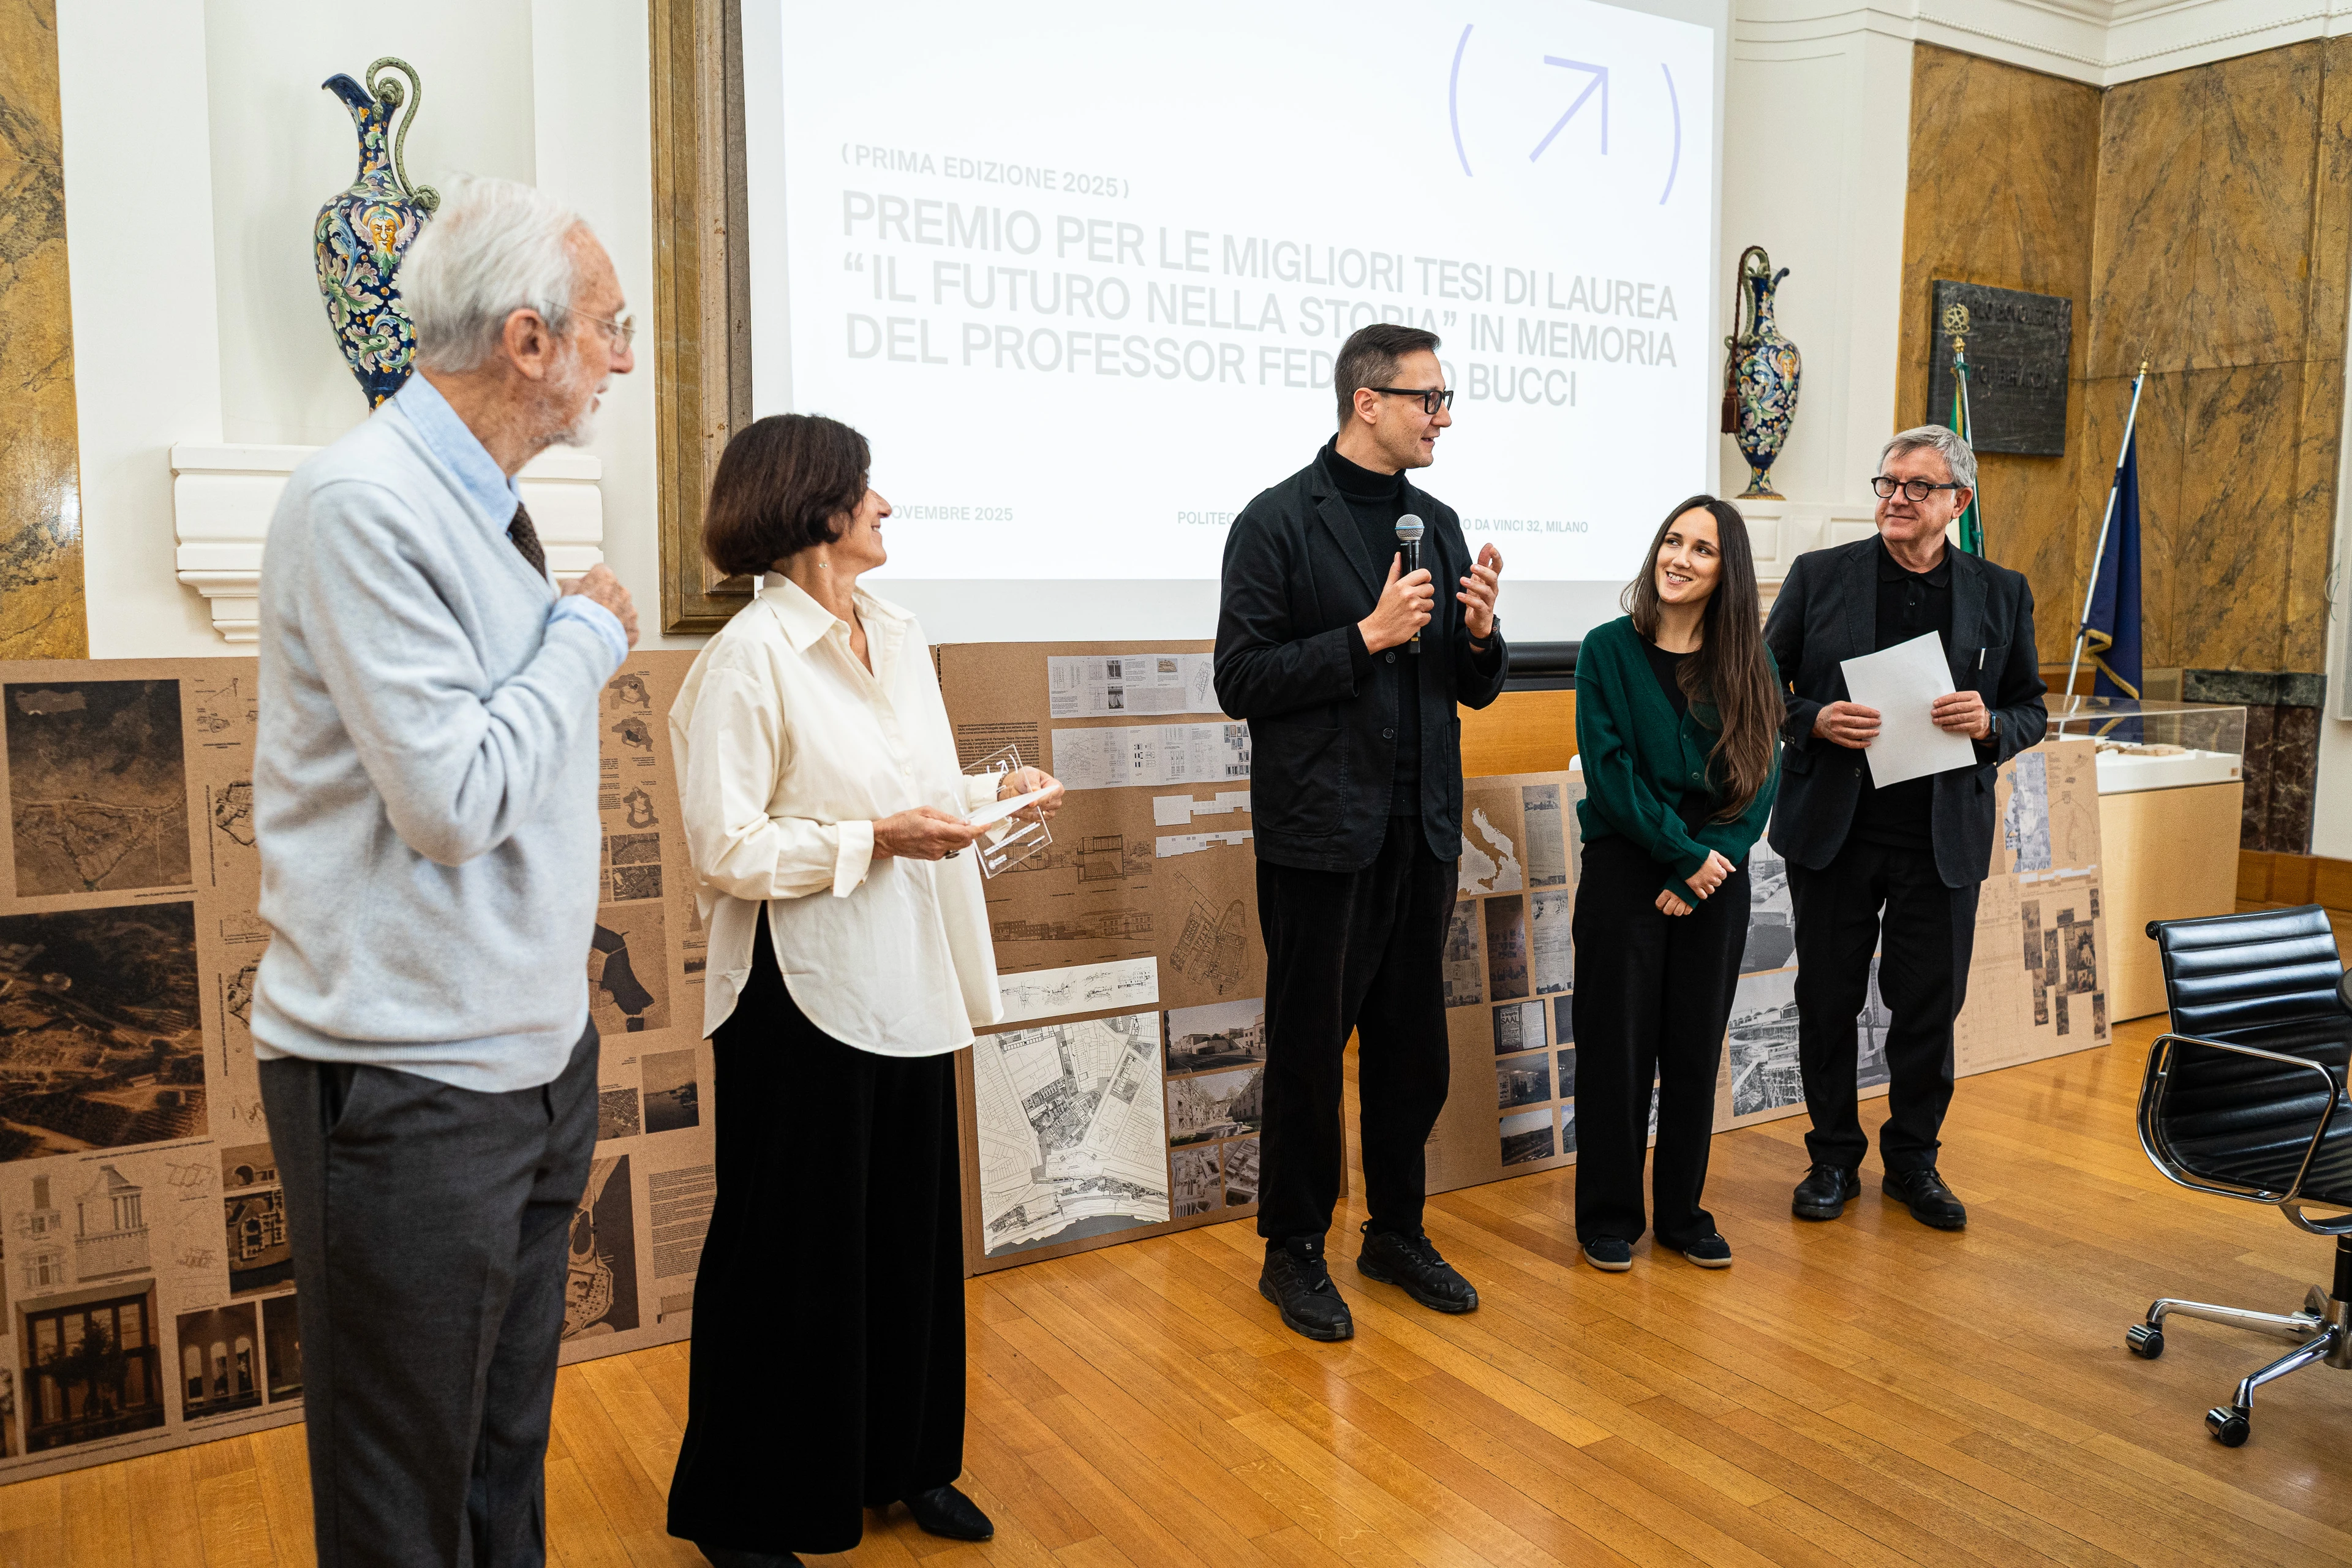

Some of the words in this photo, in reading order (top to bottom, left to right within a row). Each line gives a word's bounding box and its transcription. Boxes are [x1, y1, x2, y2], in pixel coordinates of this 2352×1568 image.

[944, 156, 1056, 190] EDIZIONE
[843, 190, 1041, 255] PREMIO
[1057, 215, 1145, 266] PER
[1159, 227, 1210, 273] LE
[1223, 234, 1403, 293] MIGLIORI
[1414, 254, 1492, 302] TESI
[1504, 267, 1536, 307] DI
[1548, 272, 1678, 322] LAUREA
[933, 260, 1130, 323] FUTURO
[1148, 281, 1287, 334] NELLA
[1471, 313, 1504, 353] IN
[1518, 317, 1678, 368] MEMORIA
[846, 313, 948, 364] DEL
[963, 322, 1246, 384] PROFESSOR
[1469, 363, 1576, 407] BUCCI
[892, 505, 970, 521] OVEMBRE
[975, 507, 1013, 521] 2025
[1178, 511, 1235, 525] POLITEC
[1475, 519, 1490, 530] DA
[1493, 519, 1524, 532] VINCI
[1526, 521, 1543, 533] 32,
[1546, 521, 1588, 533] MILANO
[1501, 1016, 1519, 1025] SAAL
